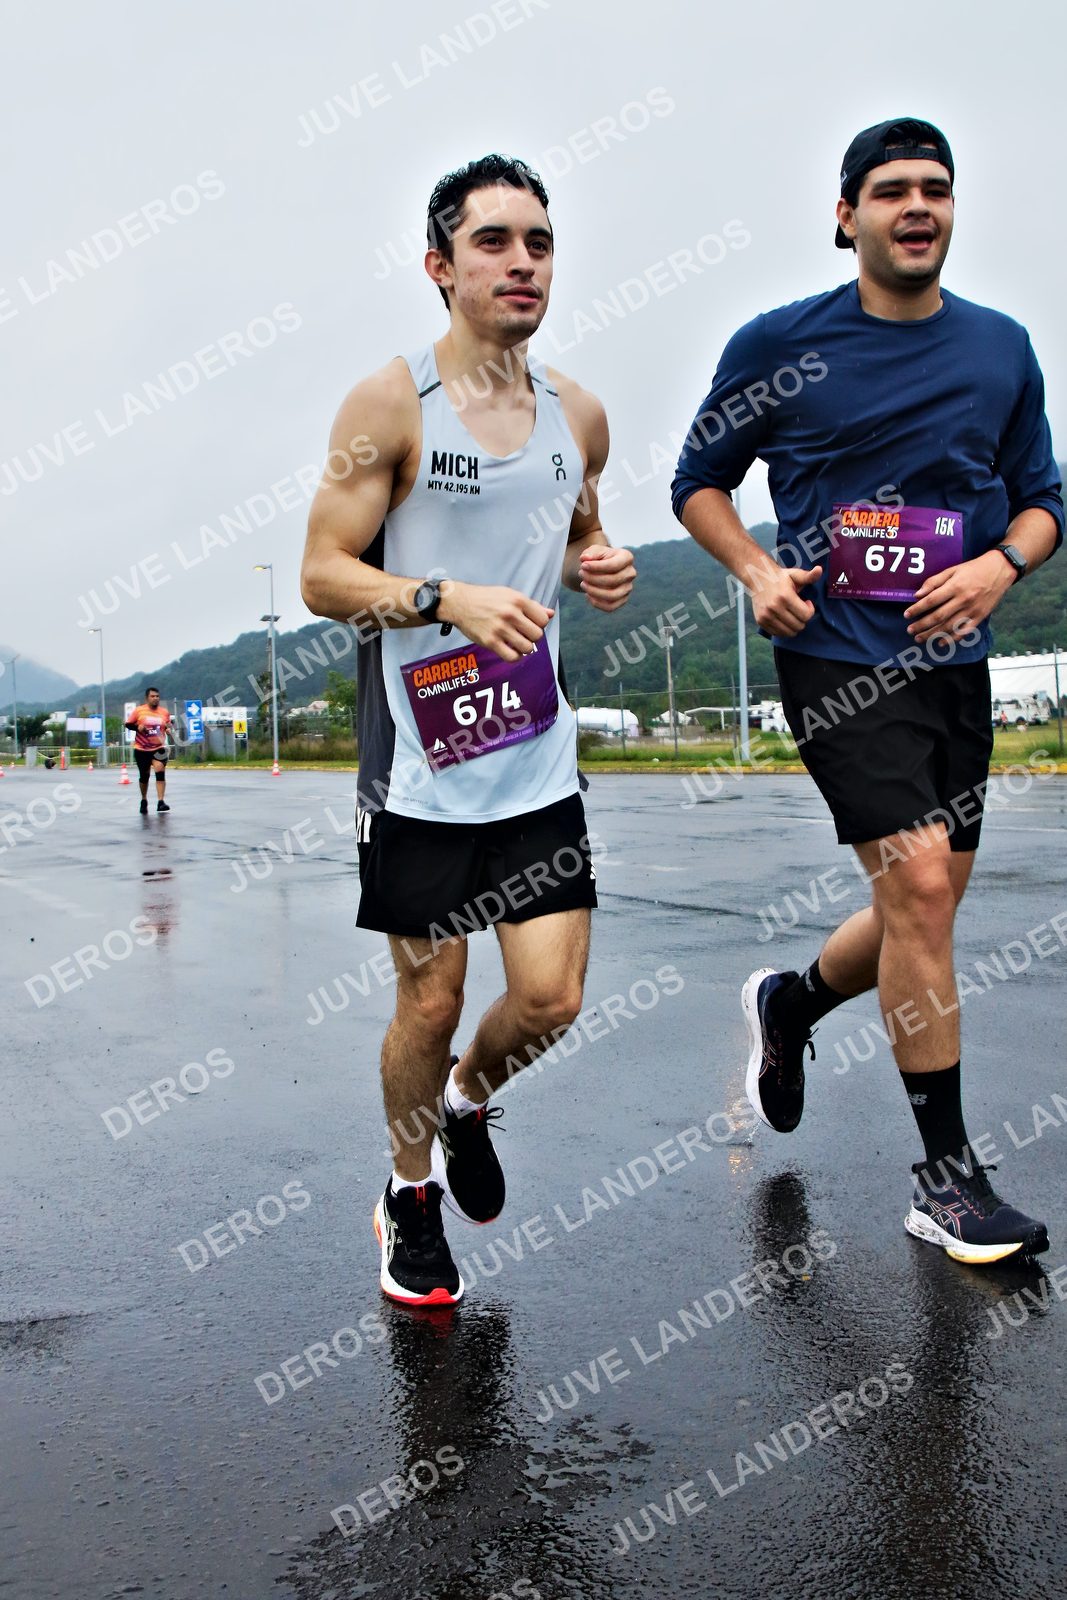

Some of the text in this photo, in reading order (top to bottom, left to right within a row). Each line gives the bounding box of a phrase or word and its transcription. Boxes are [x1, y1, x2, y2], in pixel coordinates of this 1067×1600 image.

[431, 450, 478, 480] MICH
[428, 480, 480, 495] MTY 42.195 KM
[842, 511, 900, 526] CARRERA
[934, 517, 956, 536] 15K
[865, 544, 925, 574] 673
[413, 654, 477, 687] CARRERA
[453, 682, 522, 726] 674
